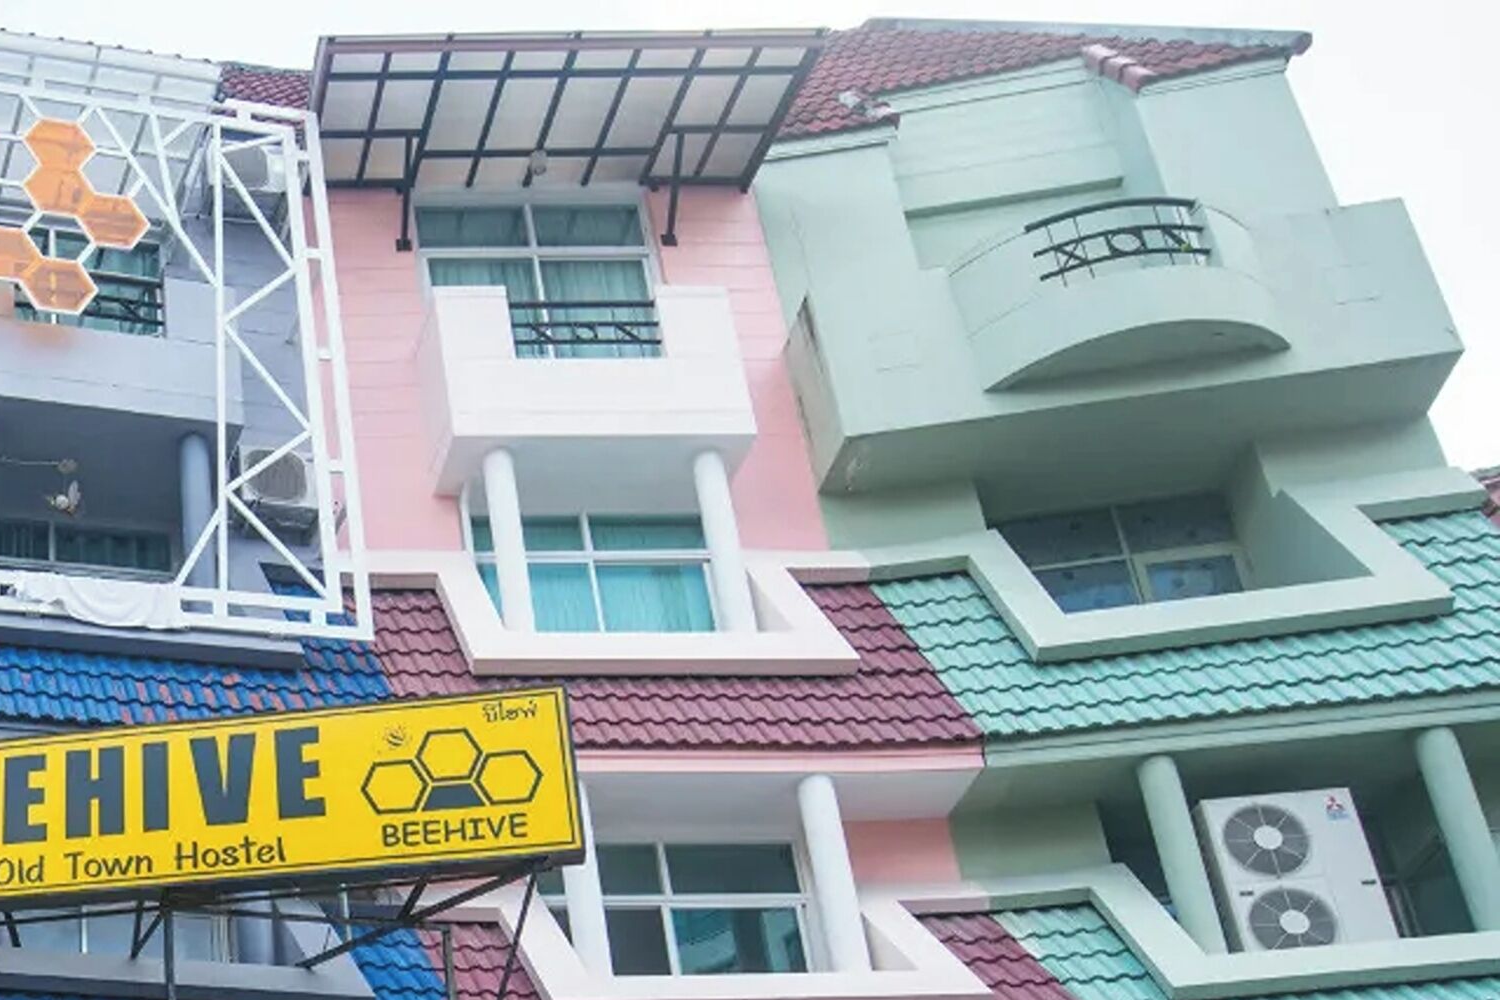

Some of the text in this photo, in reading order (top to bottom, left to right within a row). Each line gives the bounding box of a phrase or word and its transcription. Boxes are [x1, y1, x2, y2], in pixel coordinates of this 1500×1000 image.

[381, 812, 528, 847] BEEHIVE
[64, 851, 153, 880] Town
[175, 836, 287, 870] Hostel
